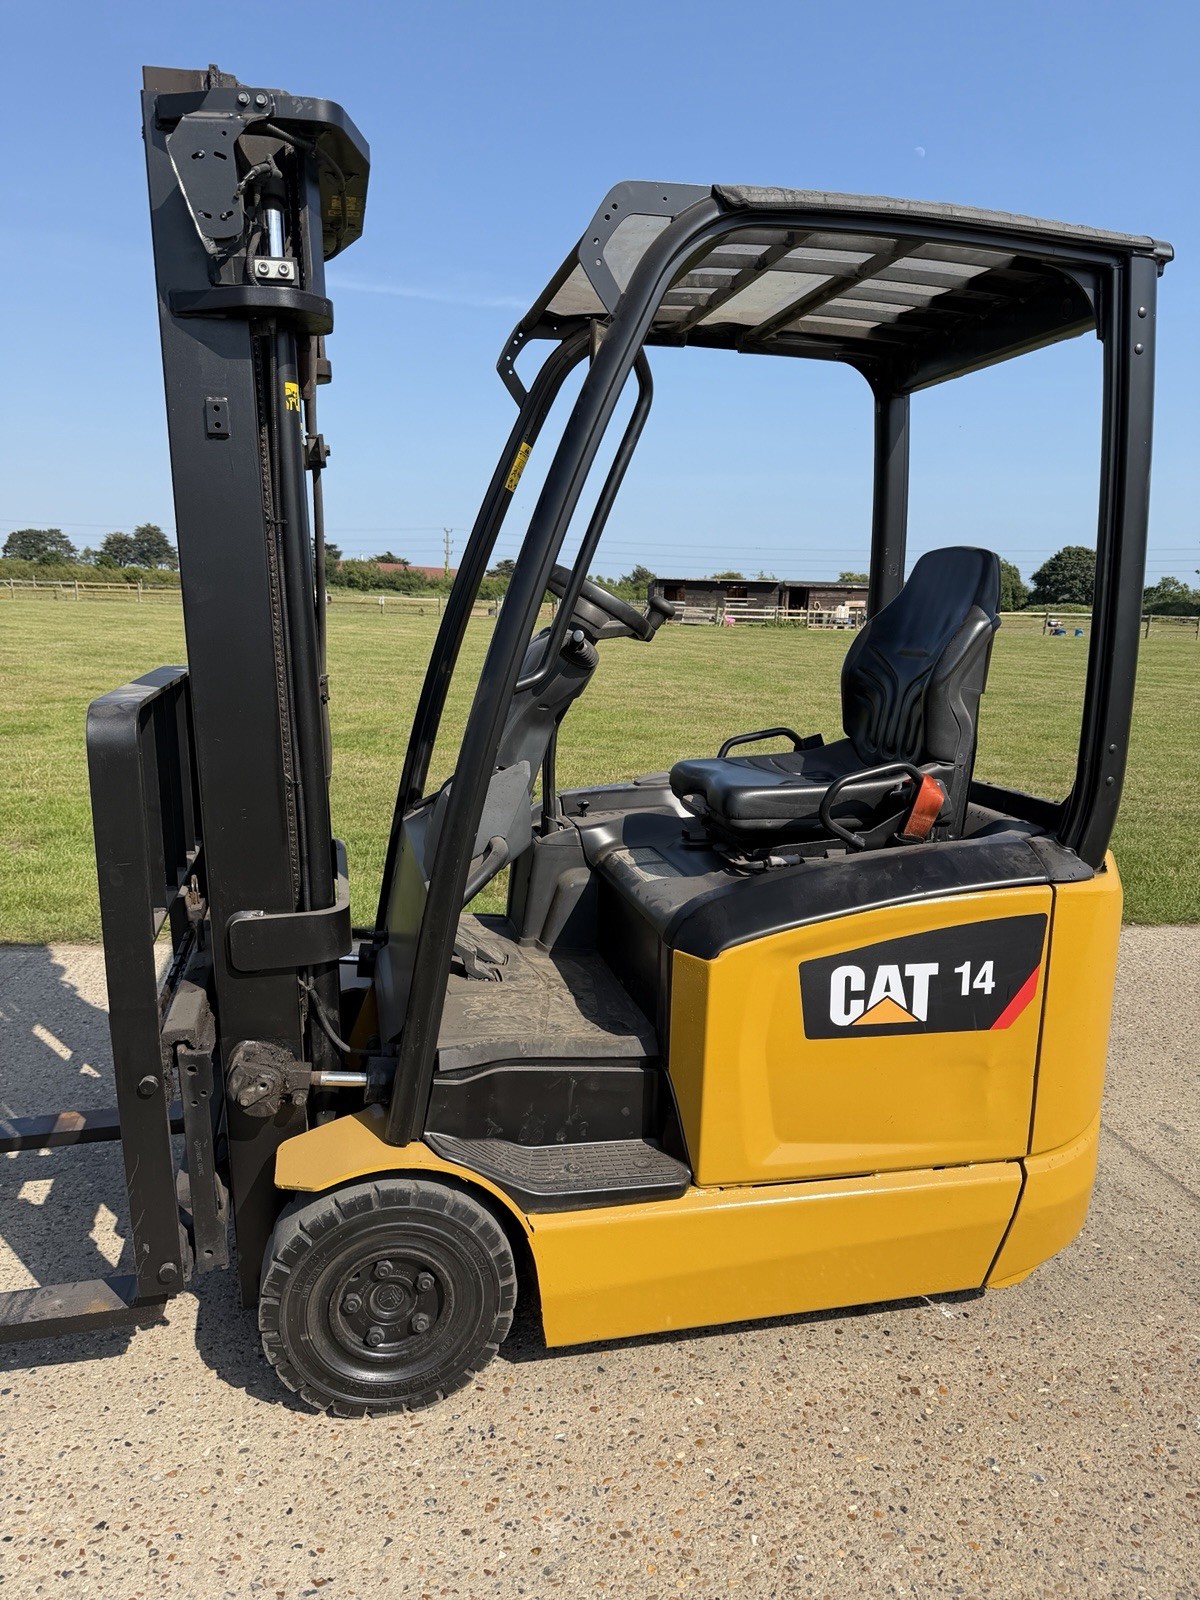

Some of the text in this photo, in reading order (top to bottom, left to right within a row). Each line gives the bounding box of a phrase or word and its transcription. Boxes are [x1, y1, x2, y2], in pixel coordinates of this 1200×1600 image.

[829, 960, 996, 1027] CAT 14
[454, 1230, 492, 1280] SOLIDEAL
